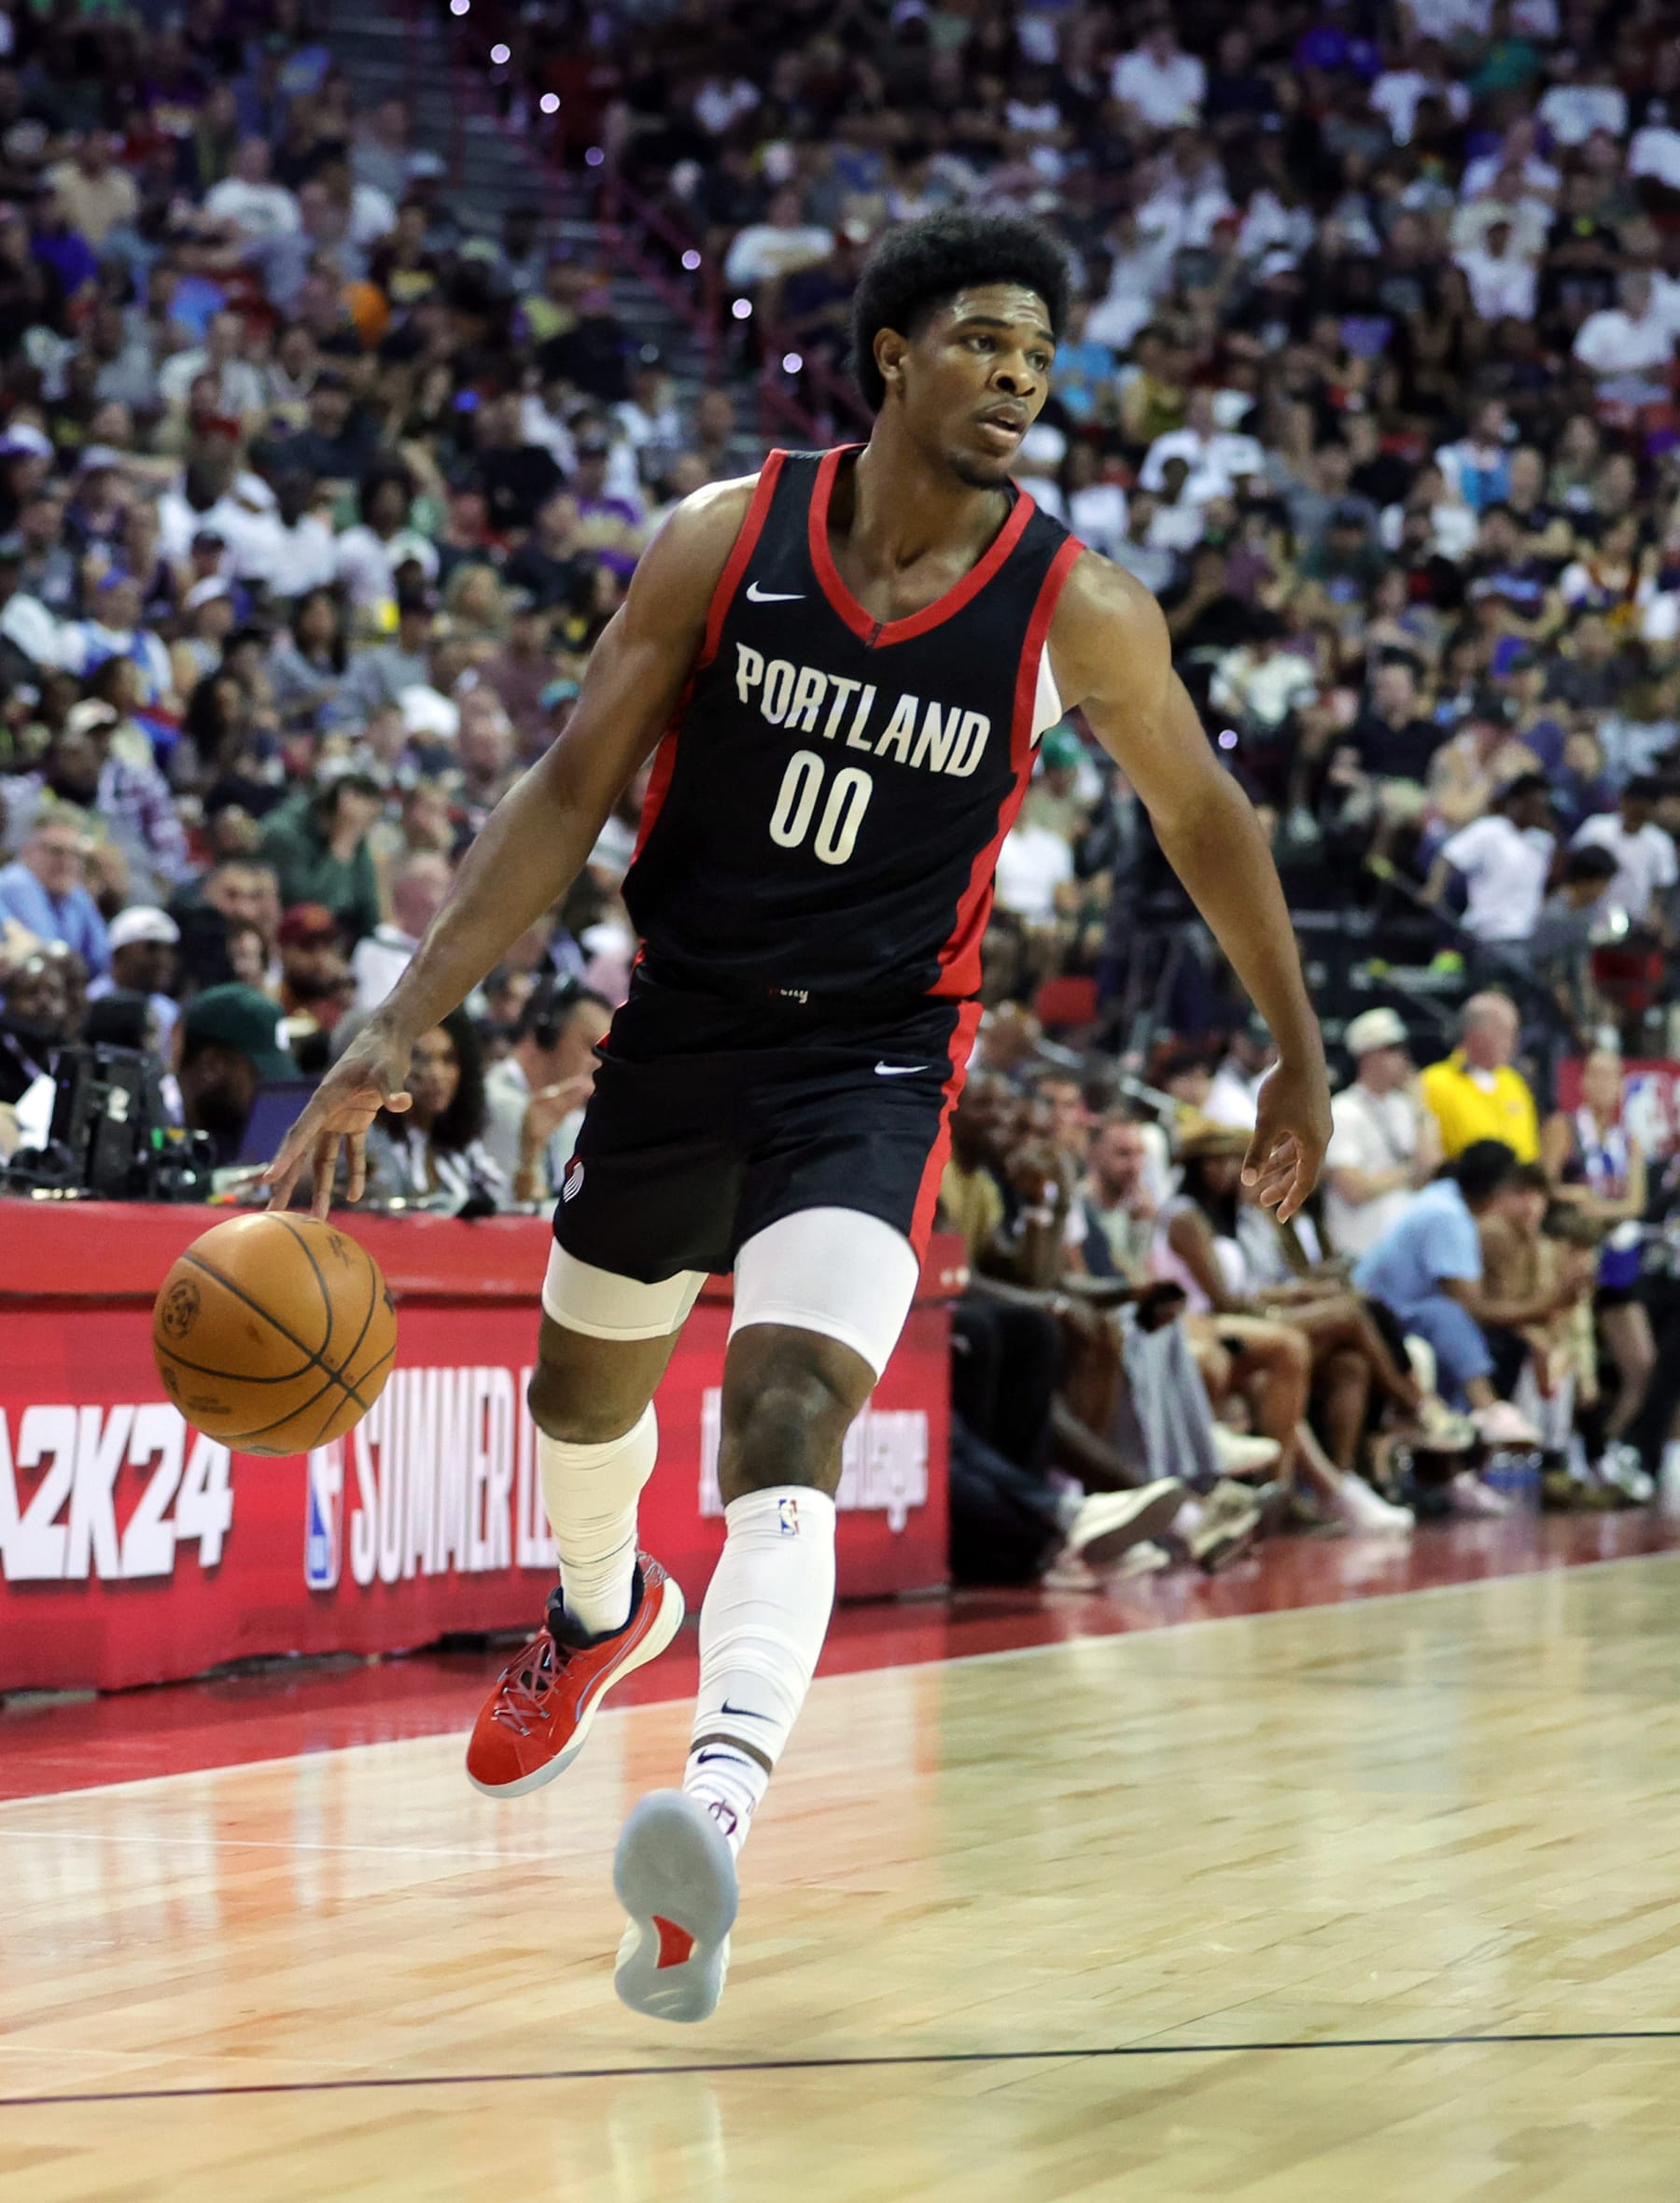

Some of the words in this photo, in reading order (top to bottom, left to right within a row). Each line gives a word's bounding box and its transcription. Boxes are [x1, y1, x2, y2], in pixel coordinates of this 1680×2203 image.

[735, 641, 991, 778] PORTLAND
[769, 750, 874, 865] 00
[350, 1366, 514, 1585] SUMMER
